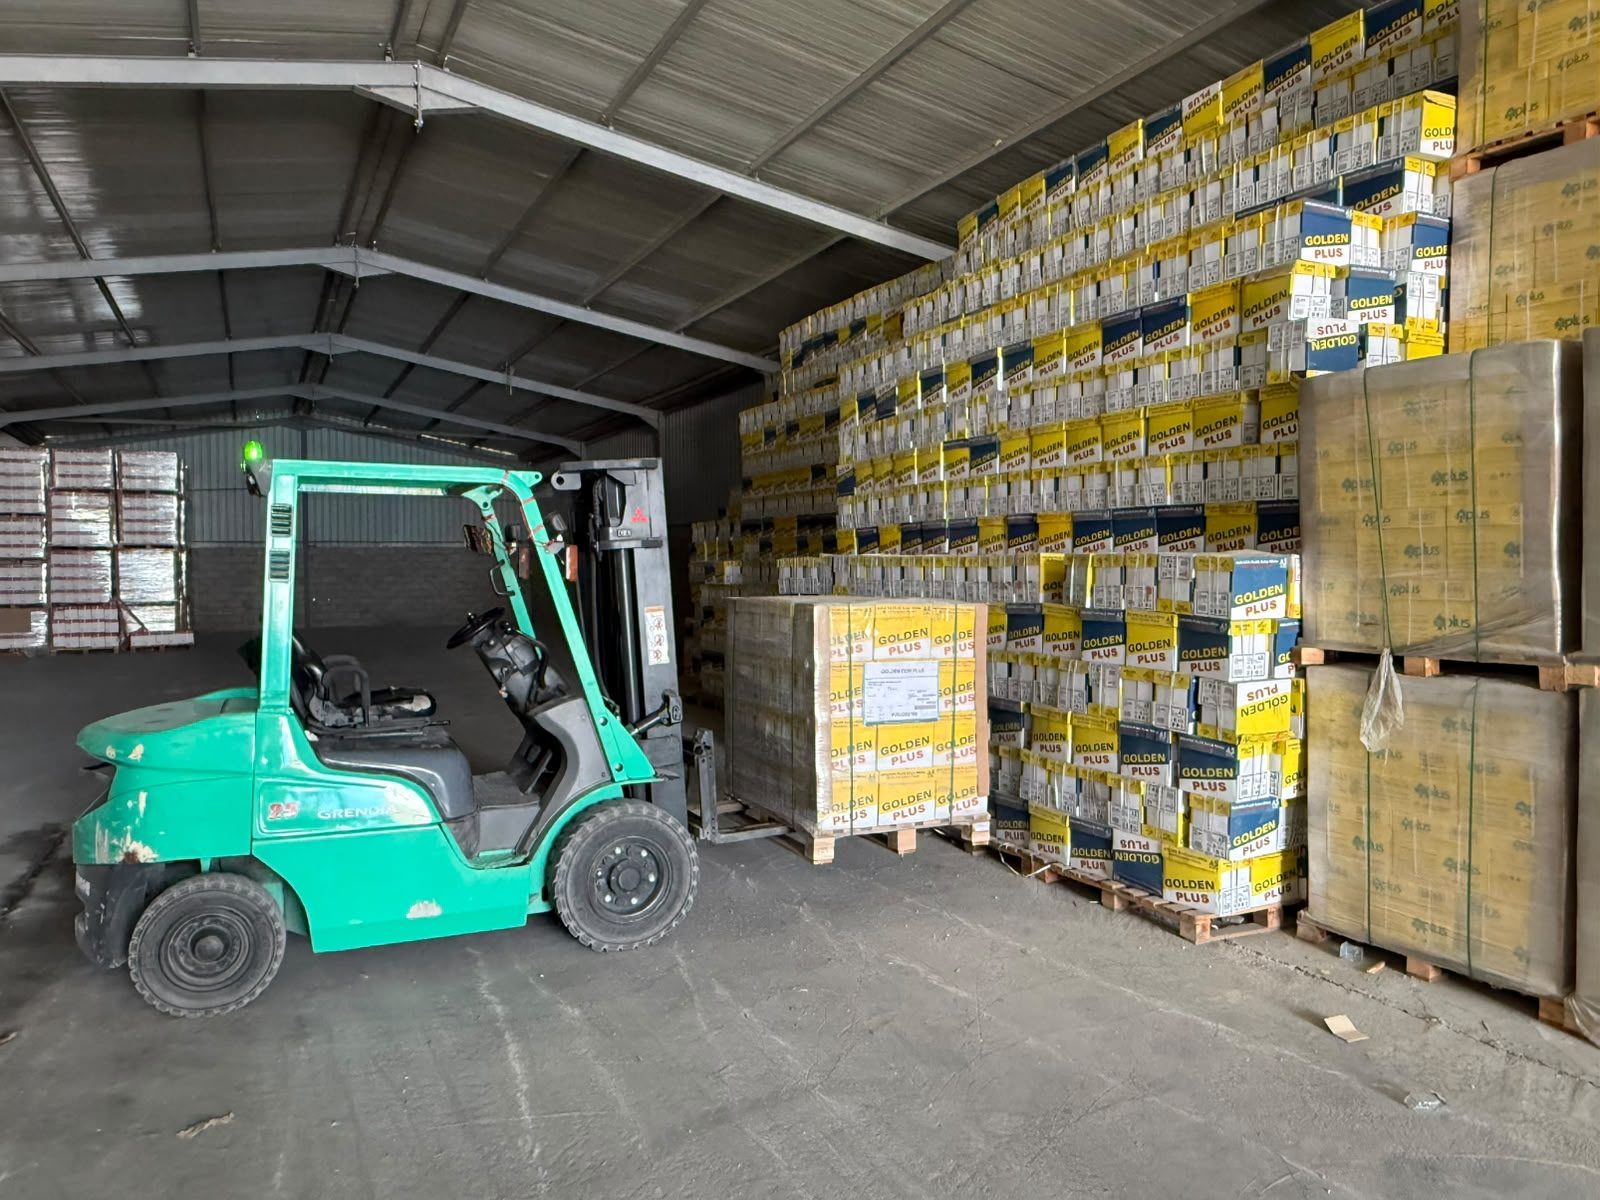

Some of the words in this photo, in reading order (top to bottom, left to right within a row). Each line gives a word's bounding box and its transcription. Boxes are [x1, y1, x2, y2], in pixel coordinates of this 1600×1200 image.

[1369, 8, 1418, 45] GOLDEN
[1379, 26, 1412, 51] PLUS
[1314, 35, 1357, 69] GOLDEN
[1322, 51, 1352, 74] PLUS
[1266, 61, 1306, 91] GOLDEN
[1275, 74, 1302, 97] PLUS
[1225, 83, 1261, 114] GOLDEN
[1233, 97, 1258, 118] PLUS
[1149, 120, 1180, 144] GOLDEN
[1425, 127, 1452, 137] GOLD
[1155, 134, 1176, 151] PLUS
[1433, 141, 1452, 150] PLU
[1116, 152, 1135, 169] PLUS
[1086, 169, 1103, 184] PLUS
[1053, 187, 1068, 200] PLUS
[1353, 184, 1400, 211] OLDEN
[1305, 234, 1348, 245] GOLDEN
[1315, 248, 1342, 258] PLUS
[1424, 257, 1447, 270] PLU
[1244, 289, 1287, 318] GOLDEN
[1350, 295, 1392, 308] GOLDEN
[1194, 305, 1235, 331] GOLDEN
[1253, 306, 1280, 327] PLUS
[1360, 309, 1387, 320] PLUS
[1145, 318, 1185, 342] GOLDEN
[1202, 320, 1231, 339] PLUS
[1317, 323, 1346, 335] PLUS
[1105, 330, 1138, 353] GOLDEN
[1154, 334, 1180, 351] PLUS
[1311, 336, 1357, 351] GOLDEN
[1067, 341, 1099, 361] GOLDEN
[1112, 344, 1135, 361] PLUS
[1034, 349, 1062, 369] GOLDEN
[1074, 353, 1095, 369] PLUS
[1039, 362, 1059, 376] PLUS
[1009, 373, 1026, 384] PLUS
[952, 387, 967, 398] PLUS
[1196, 416, 1237, 437] GOLDEN
[1263, 411, 1298, 430] GOLD
[1150, 422, 1190, 443] GOLDEN
[1204, 430, 1232, 446] PLUS
[1274, 424, 1297, 440] PLU
[1067, 436, 1098, 454] GOLDEN
[1105, 430, 1139, 450] GOLDEN
[1158, 436, 1185, 451] PLUS
[1000, 445, 1028, 463] GOLDEN
[1033, 441, 1062, 458] GOLDEN
[1074, 450, 1094, 461] PLUS
[1113, 445, 1136, 457] PLUS
[1007, 458, 1025, 470] PLUS
[1040, 454, 1060, 465] PLUS
[950, 467, 965, 477] PLUS
[976, 463, 993, 474] PLUS
[1009, 533, 1036, 546] GOLDEN
[1039, 530, 1070, 545] GOLDEN
[1075, 529, 1110, 545] GOLDEN
[1116, 528, 1153, 544] GOLDEN
[1161, 528, 1201, 543] GOLDEN
[1207, 525, 1251, 543] GOLDEN
[1261, 527, 1300, 541] GOLDE
[957, 545, 973, 554] PLUS
[985, 543, 1003, 554] PLUS
[1015, 544, 1035, 553] PLUS
[1045, 542, 1065, 552] PLUS
[1083, 542, 1105, 553] PLUS
[1124, 541, 1148, 552] PLUS
[1169, 540, 1196, 552] PLUS
[1217, 539, 1245, 551] PLUS
[1234, 584, 1283, 605] GOLDEN
[1245, 600, 1277, 616] PLUS
[879, 628, 928, 645] GOLDEN
[1009, 625, 1040, 637] GOLDEN
[1045, 631, 1080, 642] GOLDEN
[889, 642, 921, 655] PLUS
[1015, 638, 1035, 648] PLUS
[1053, 643, 1075, 652] PLUS
[1083, 635, 1122, 649] GOLDEN
[1128, 639, 1170, 652] GOLDEN
[1092, 648, 1117, 659] PLUS
[1137, 653, 1165, 663] PLUS
[1182, 647, 1226, 659] GOLDEN
[1190, 662, 1220, 672] PLUS
[1247, 685, 1278, 701] PLUS
[1241, 694, 1288, 717] GOLDEN
[998, 734, 1016, 742] PLUS
[1034, 733, 1065, 741] GOLDEN
[881, 736, 930, 755] GOLDEN
[1040, 743, 1061, 752] PLUS
[1076, 743, 1113, 753] GOLDEN
[891, 750, 923, 765] PLUS
[1084, 756, 1109, 764] PLUS
[1123, 754, 1165, 763] GOLDEN
[1132, 767, 1160, 775] PLUS
[1182, 768, 1233, 777] GOLDEN
[1193, 781, 1227, 791] PLUS
[882, 790, 931, 811] GOLDEN
[833, 810, 867, 825] PLUS
[893, 805, 925, 820] PLUS
[1031, 832, 1064, 843] GOLDEN
[1233, 820, 1276, 846] GOLDEN
[1038, 843, 1060, 854] PLUS
[1120, 840, 1149, 849] PLUS
[1243, 837, 1270, 856] PLUS
[1072, 848, 1110, 857] GOLDEN
[1115, 853, 1159, 864] GOLDEN
[1081, 860, 1106, 870] PLUS
[1165, 879, 1214, 889] GOLDEN
[1254, 868, 1296, 892] GOLDEN
[1176, 892, 1209, 903] PLUS
[1265, 884, 1291, 901] PLUS
